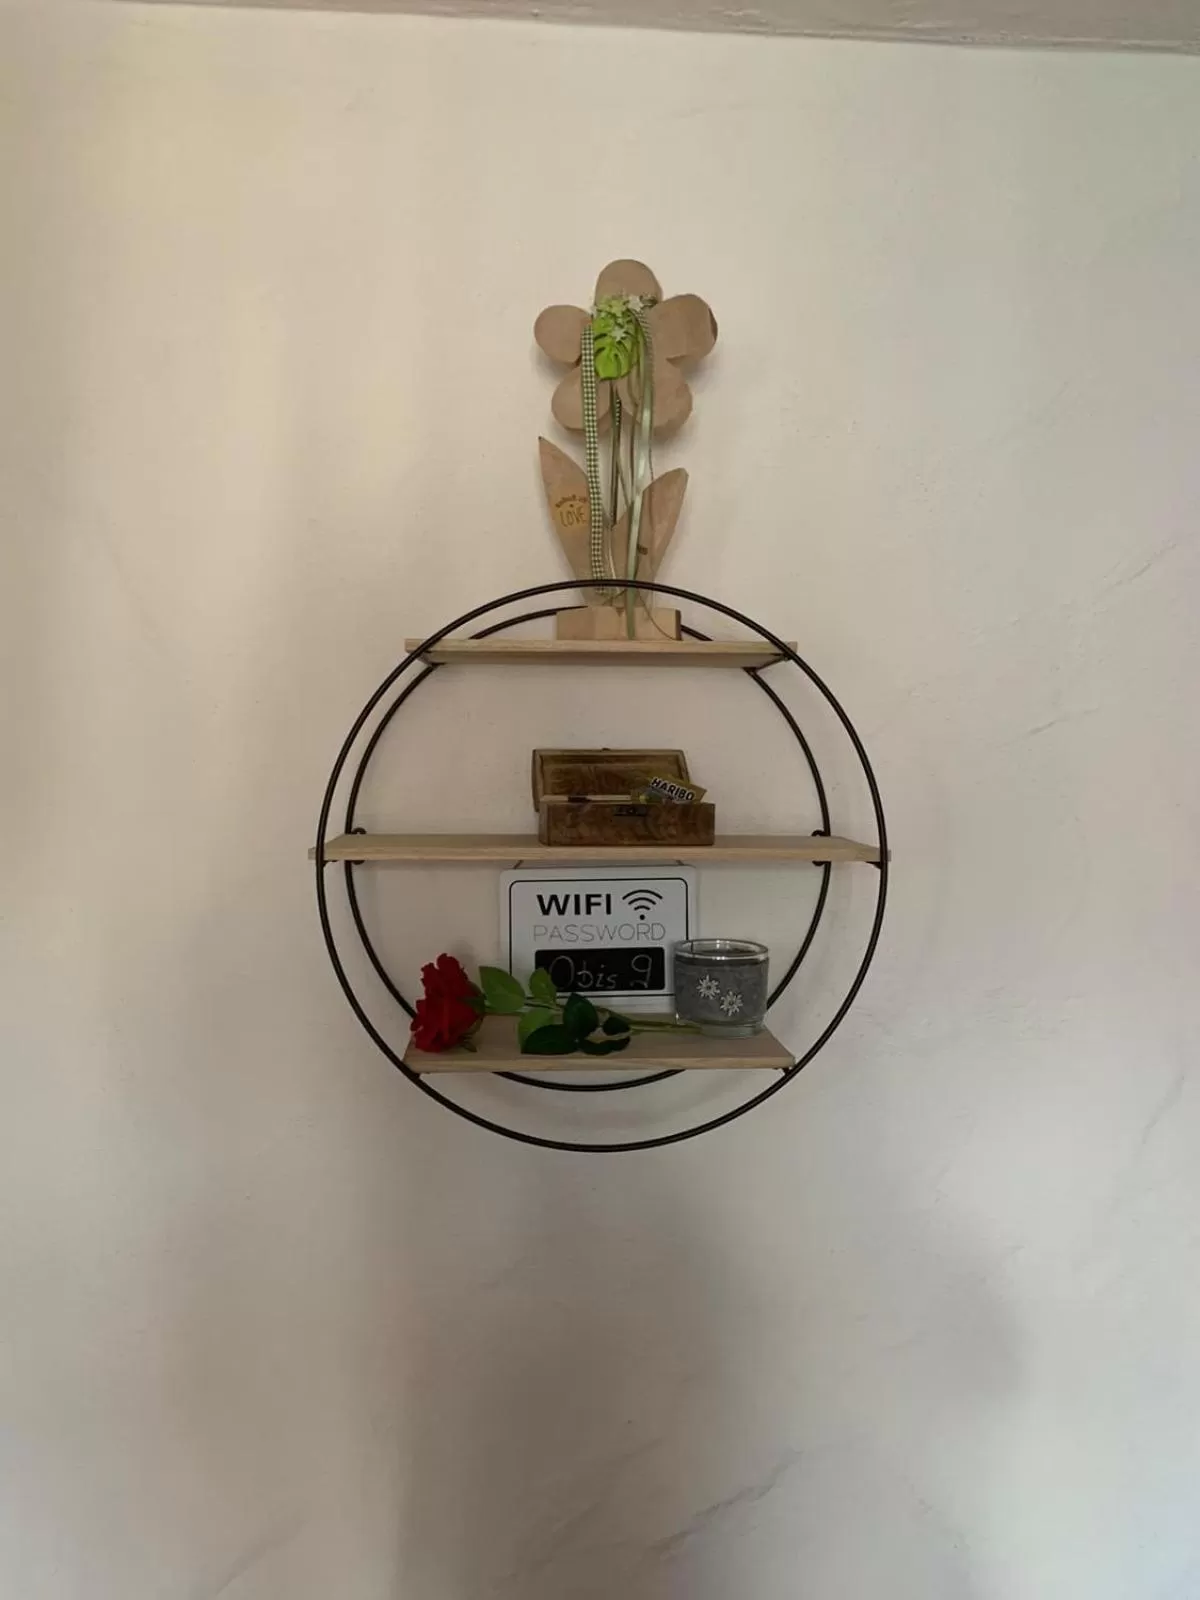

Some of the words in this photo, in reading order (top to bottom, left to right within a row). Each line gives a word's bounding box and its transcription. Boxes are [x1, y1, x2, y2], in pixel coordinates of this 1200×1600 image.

[651, 777, 696, 801] HARIBO
[536, 893, 612, 916] WIFI
[533, 922, 666, 943] PASSWORD
